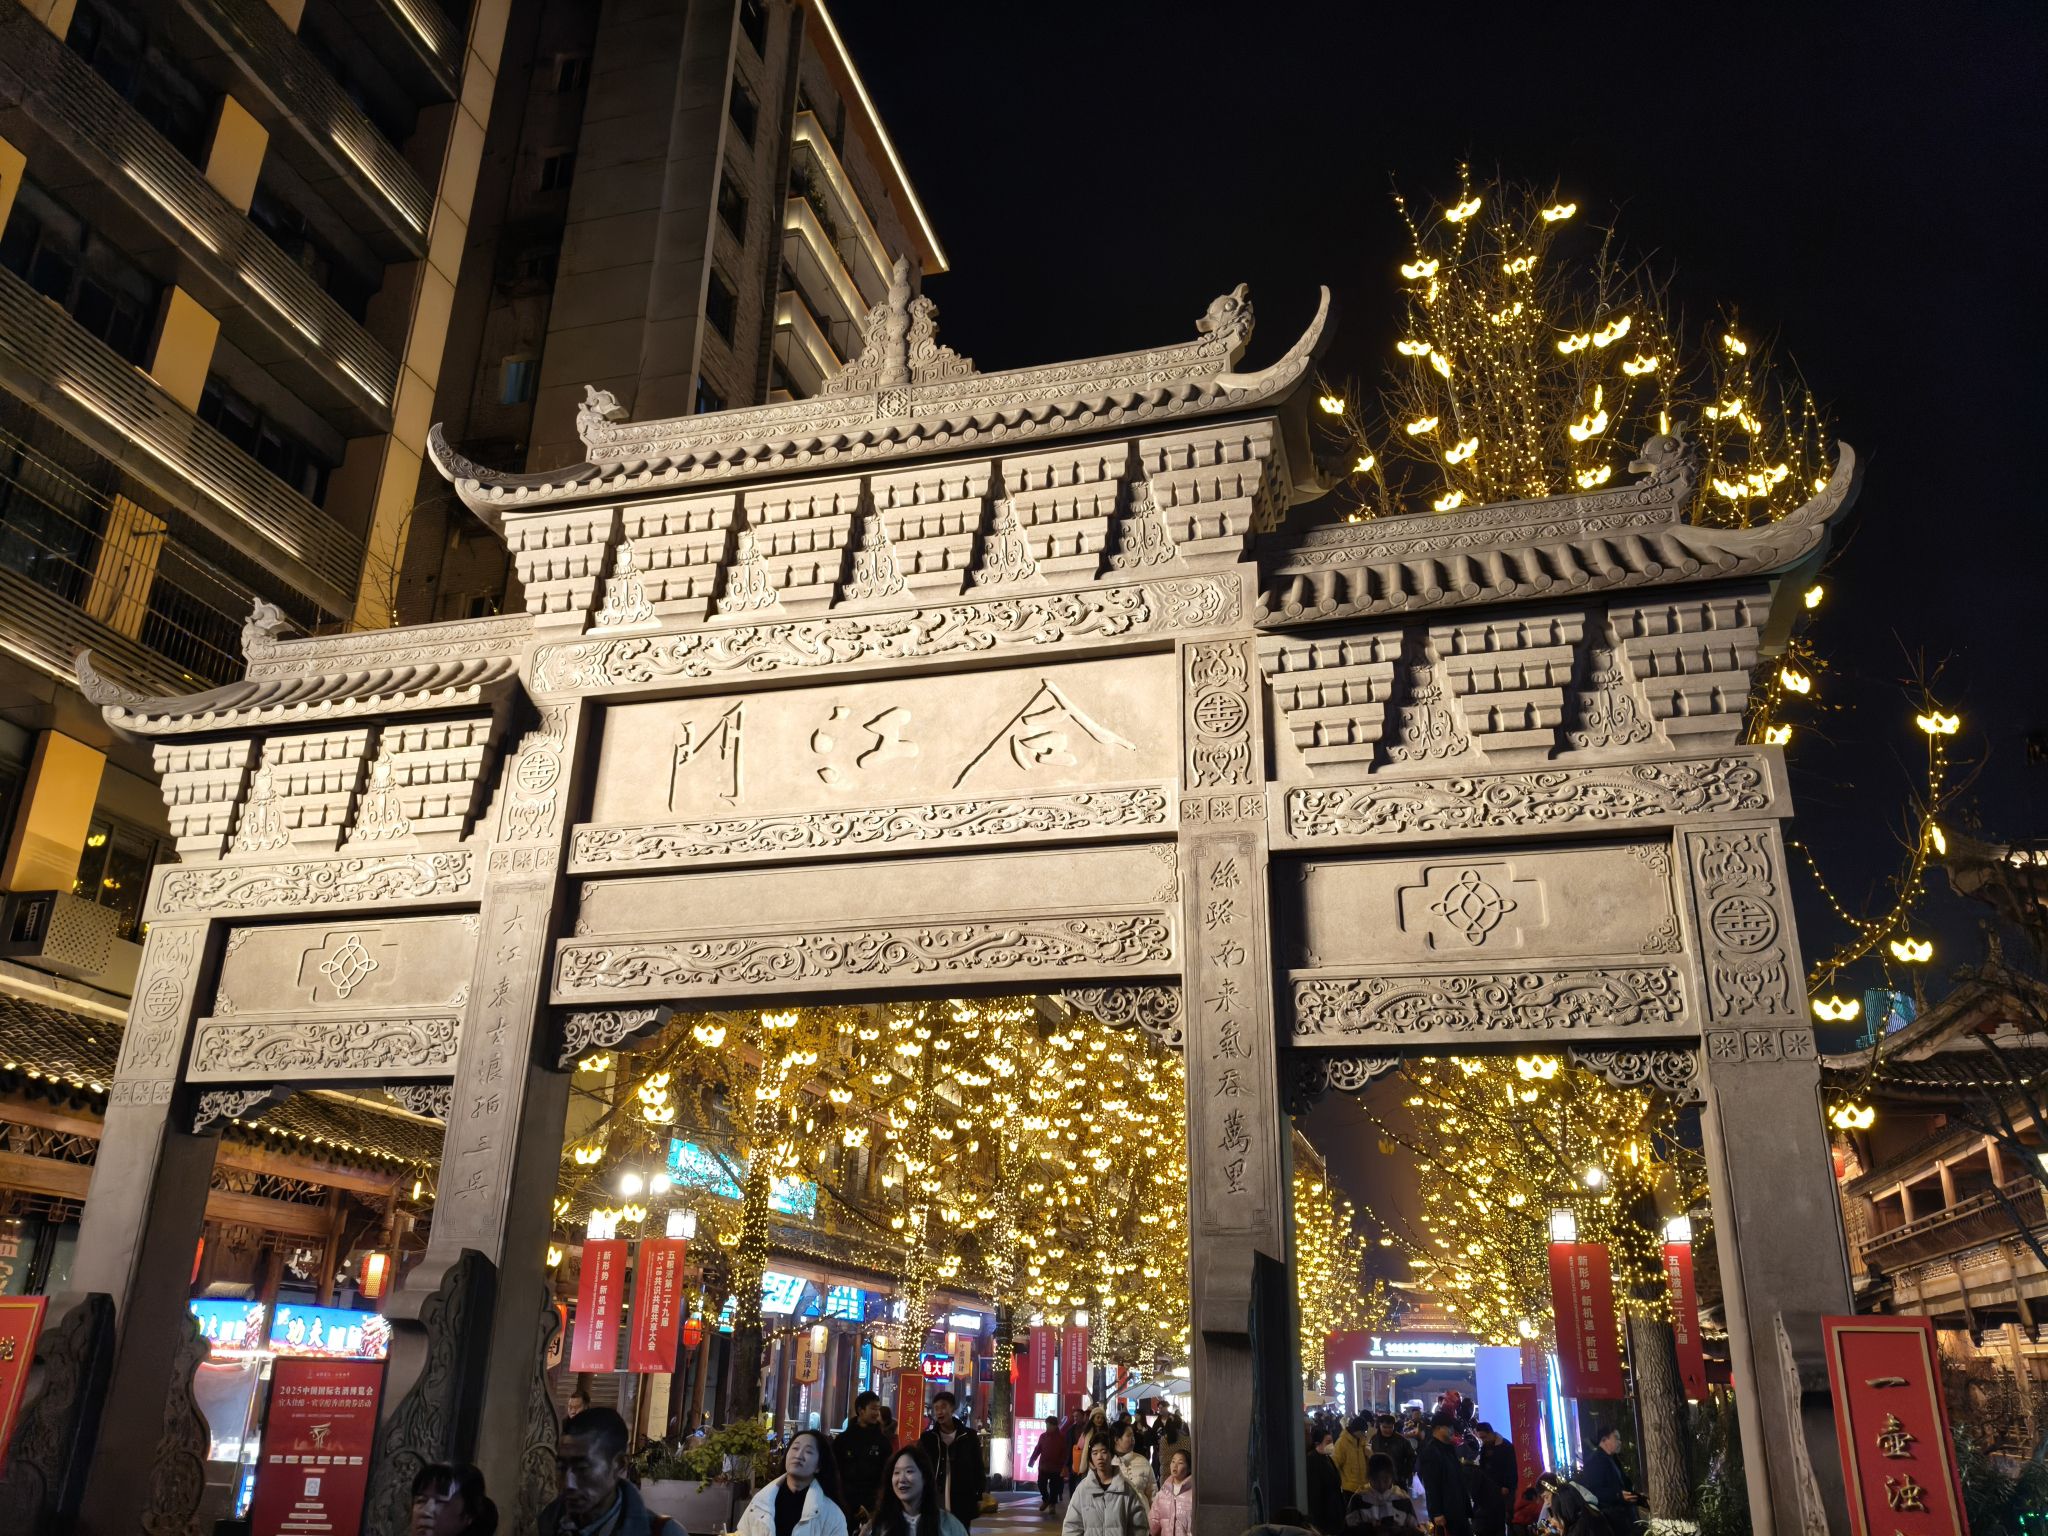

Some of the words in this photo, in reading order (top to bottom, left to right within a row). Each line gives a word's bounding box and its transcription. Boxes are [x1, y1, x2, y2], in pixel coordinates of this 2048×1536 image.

[600, 1250, 612, 1281] 新形势
[1577, 1255, 1591, 1290] 新形势
[597, 1285, 608, 1316] 新机遇
[661, 1250, 676, 1327] 五粮液第二十九届
[1668, 1255, 1688, 1345] 五粮液第二十九届
[1581, 1296, 1595, 1331] 新机遇
[593, 1319, 604, 1351] 新征程
[1585, 1336, 1599, 1372] 新征程
[279, 1385, 375, 1397] 2025中国国际名酒博览会
[1865, 1376, 1925, 1536] 一壶浊
